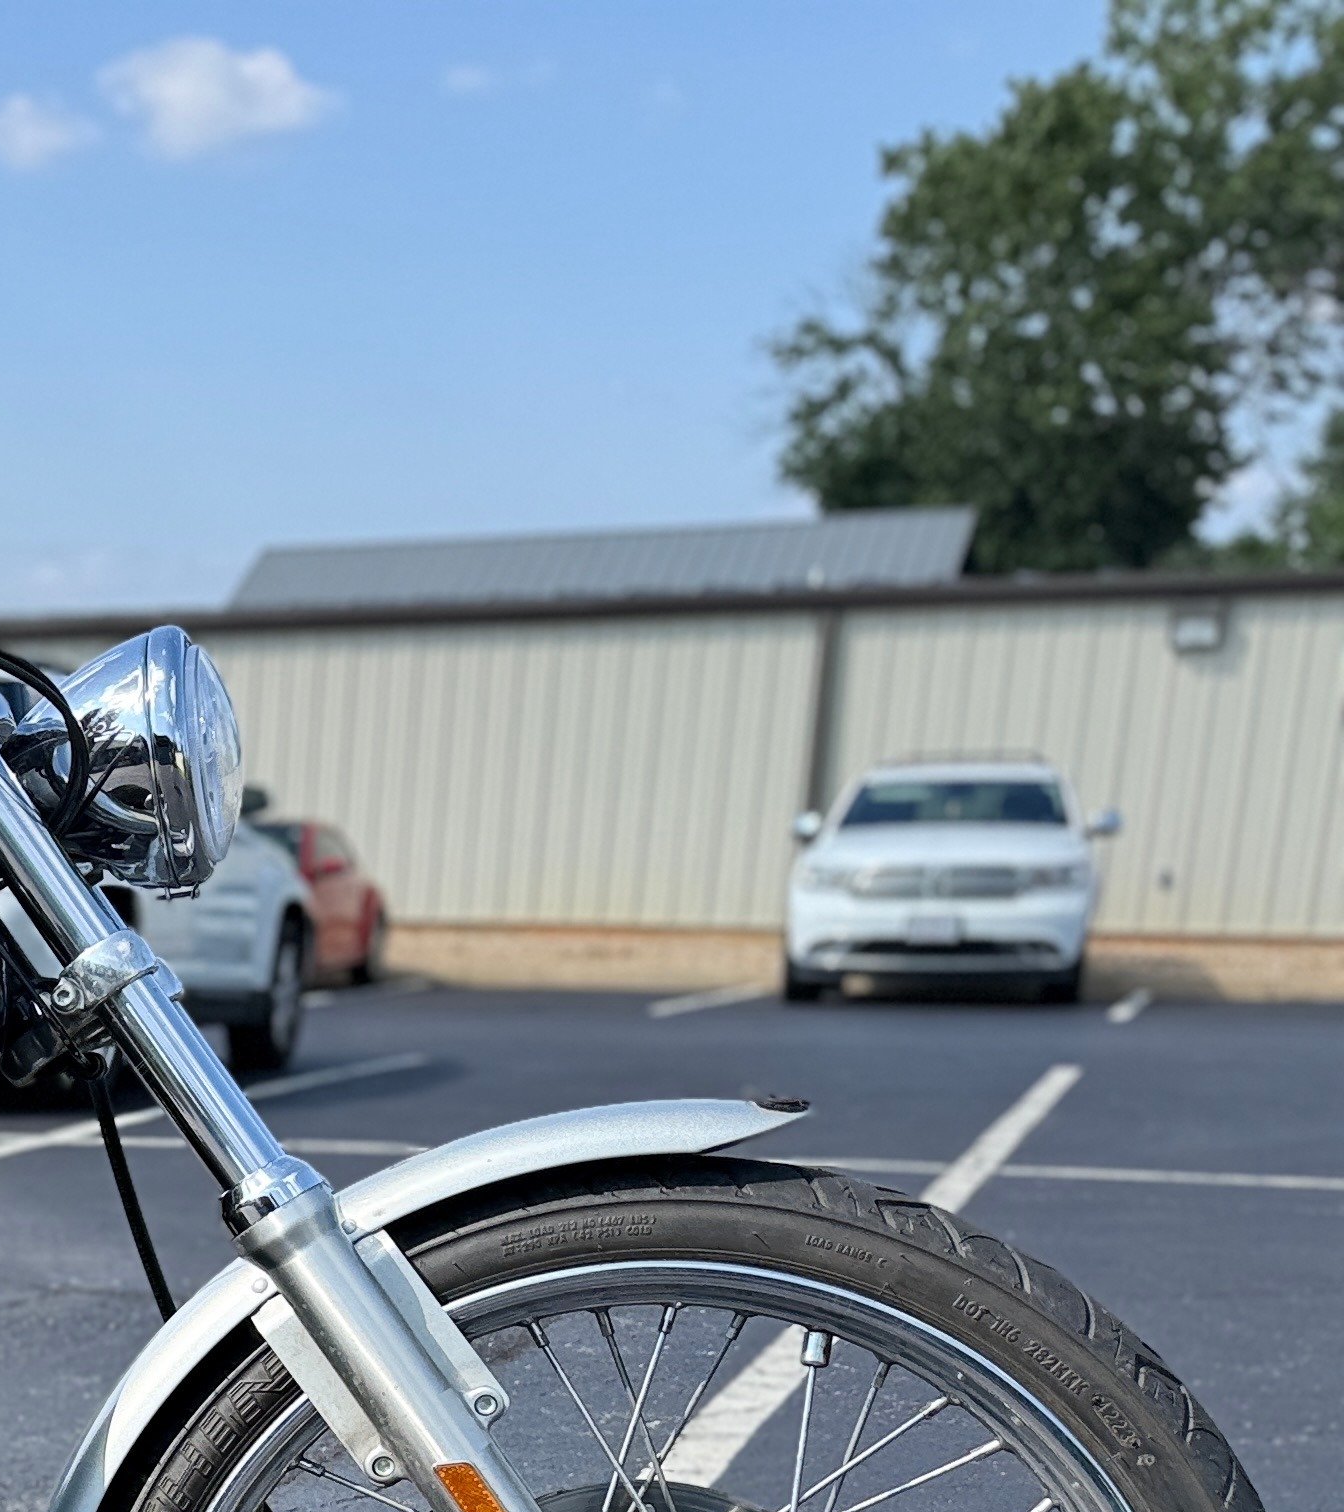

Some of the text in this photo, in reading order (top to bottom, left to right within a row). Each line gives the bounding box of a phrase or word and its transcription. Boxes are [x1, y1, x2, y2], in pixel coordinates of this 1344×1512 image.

[805, 1235, 833, 1250] LOAD
[835, 1243, 872, 1263] RANGE
[952, 1294, 988, 1321] DOT
